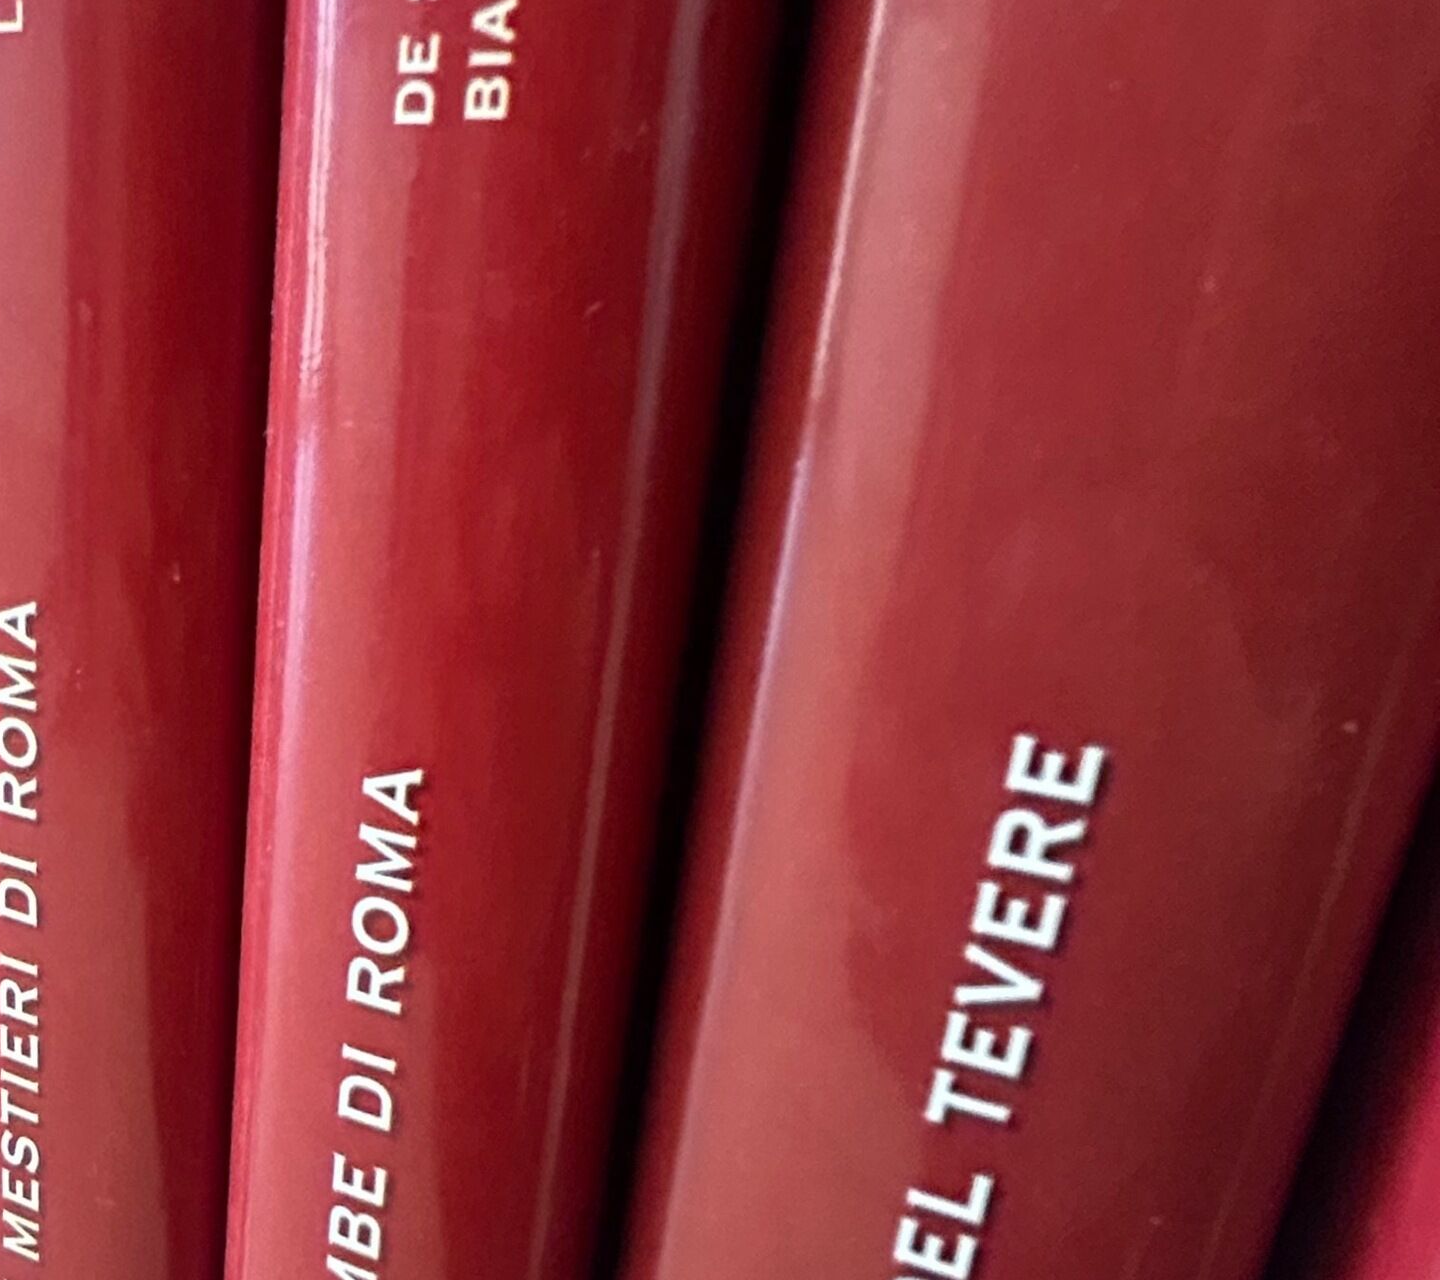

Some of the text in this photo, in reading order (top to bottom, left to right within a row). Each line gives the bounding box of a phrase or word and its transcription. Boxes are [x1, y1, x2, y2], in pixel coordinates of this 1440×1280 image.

[393, 31, 441, 125] DE
[346, 768, 425, 1016] ROMA
[923, 733, 1106, 1124] TEVERE
[337, 1043, 397, 1133] DI
